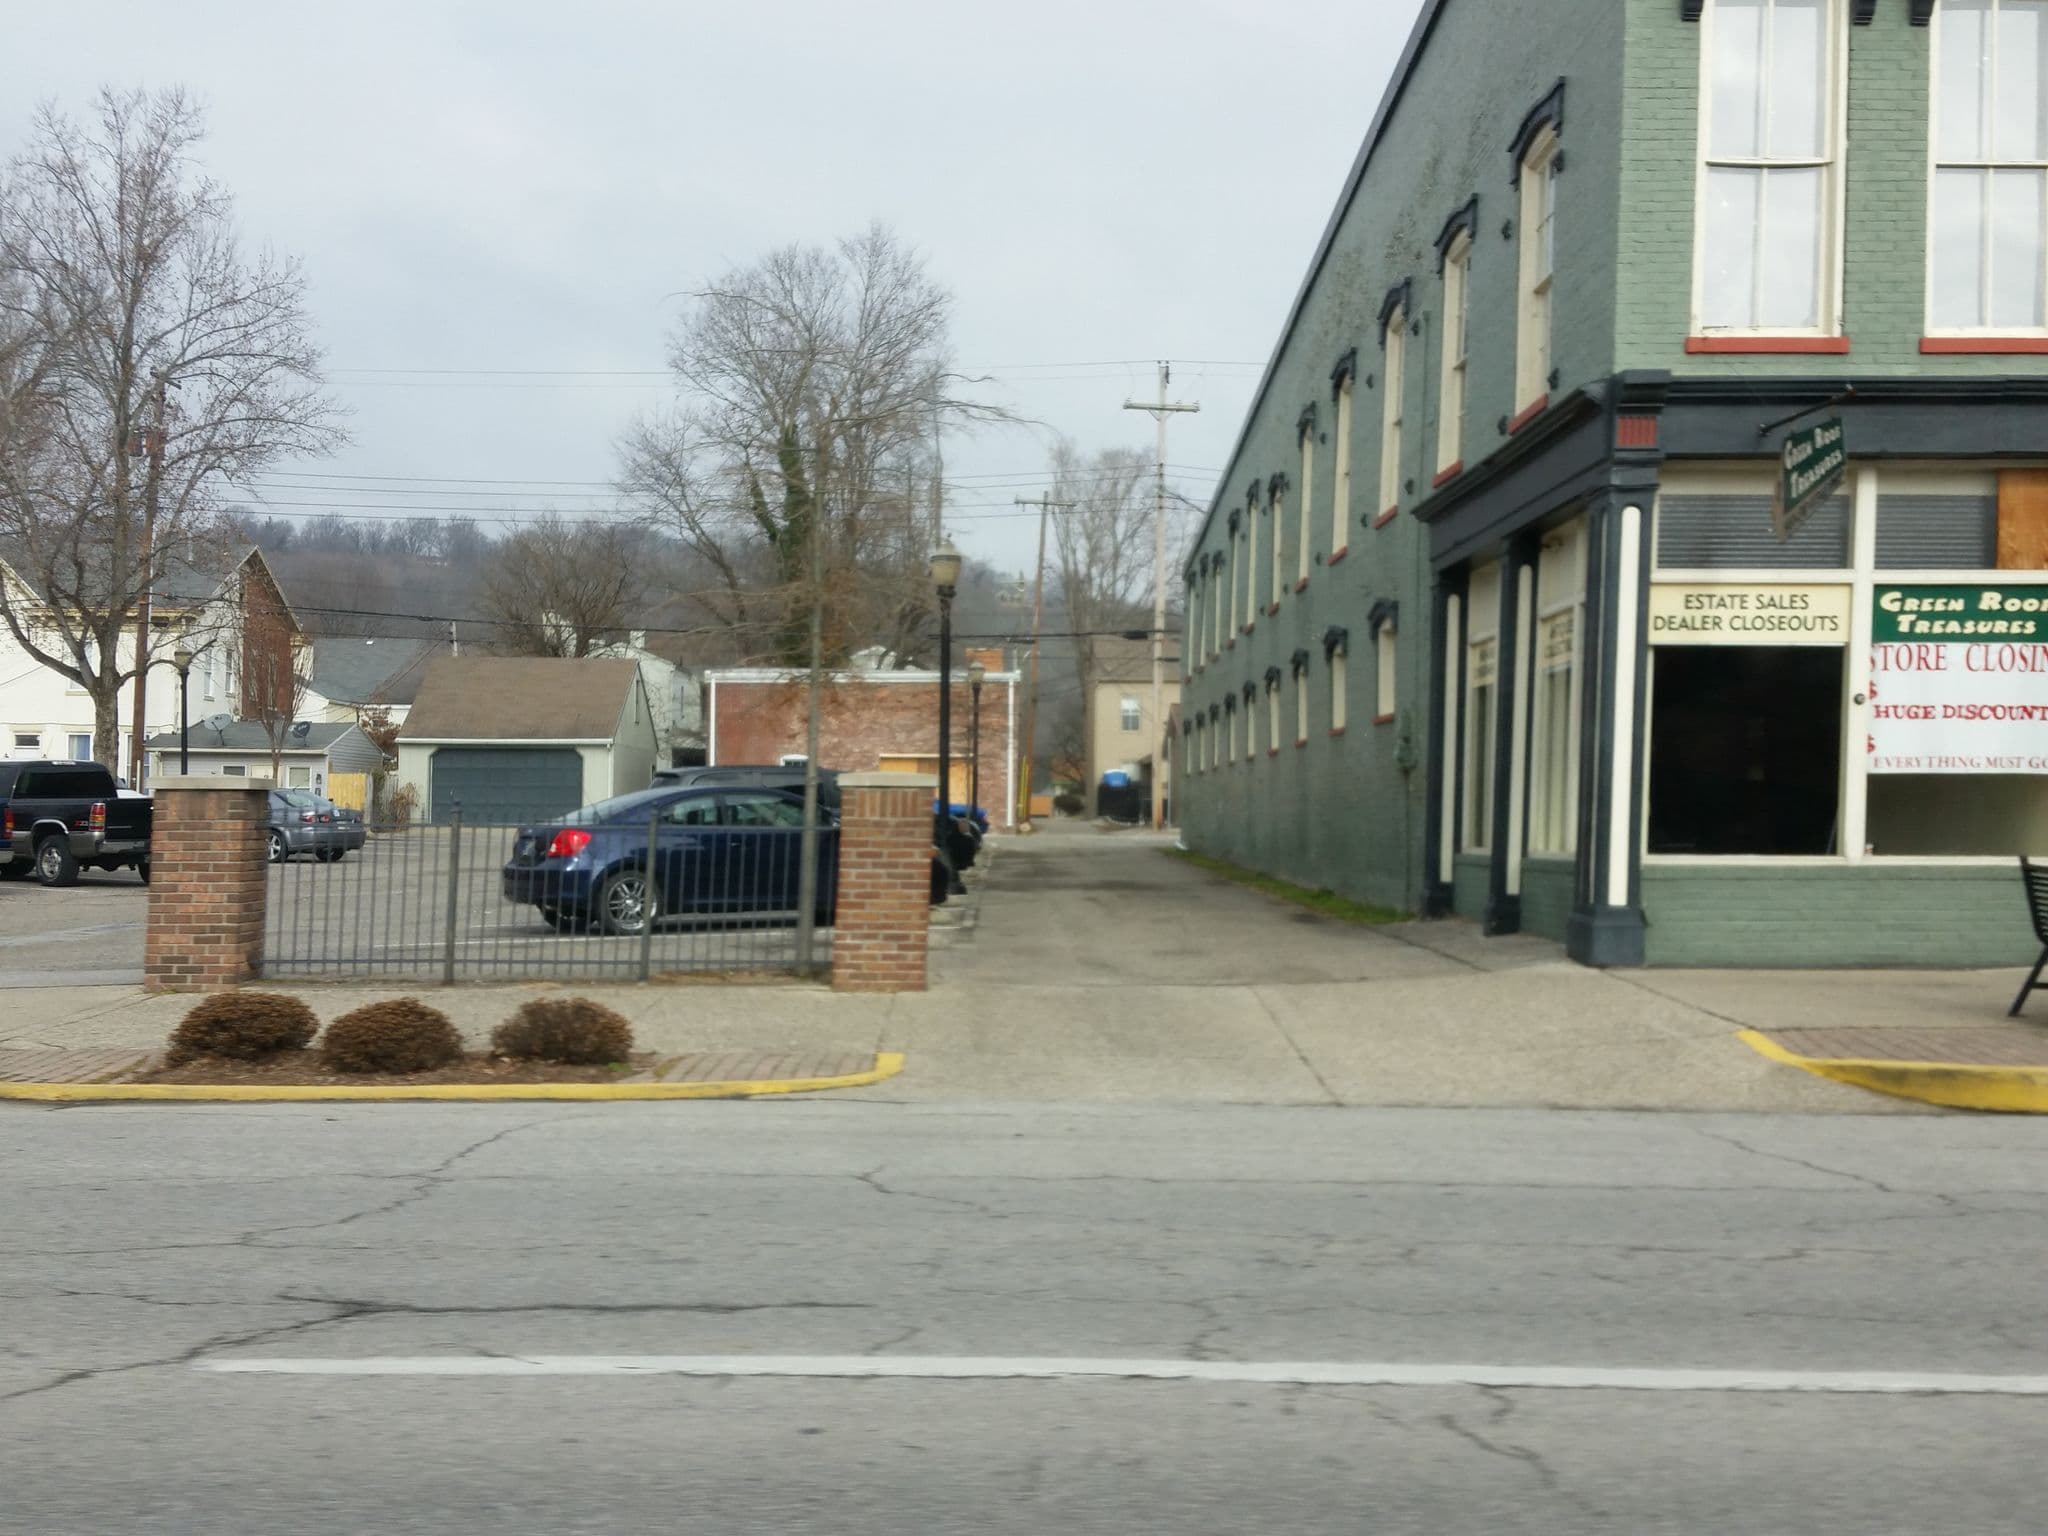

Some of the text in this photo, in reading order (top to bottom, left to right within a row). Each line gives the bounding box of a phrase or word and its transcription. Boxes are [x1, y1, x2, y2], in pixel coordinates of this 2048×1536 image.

[1790, 449, 1842, 498] TREASURES
[1684, 594, 1809, 610] ESTATE SALES
[1879, 591, 1965, 612] GREEN
[1653, 615, 1839, 631] DEALER CLOSEOUTS
[1897, 614, 2036, 634] TREASURES
[1873, 704, 1936, 720] HUGE
[1985, 756, 2025, 769] MUST
